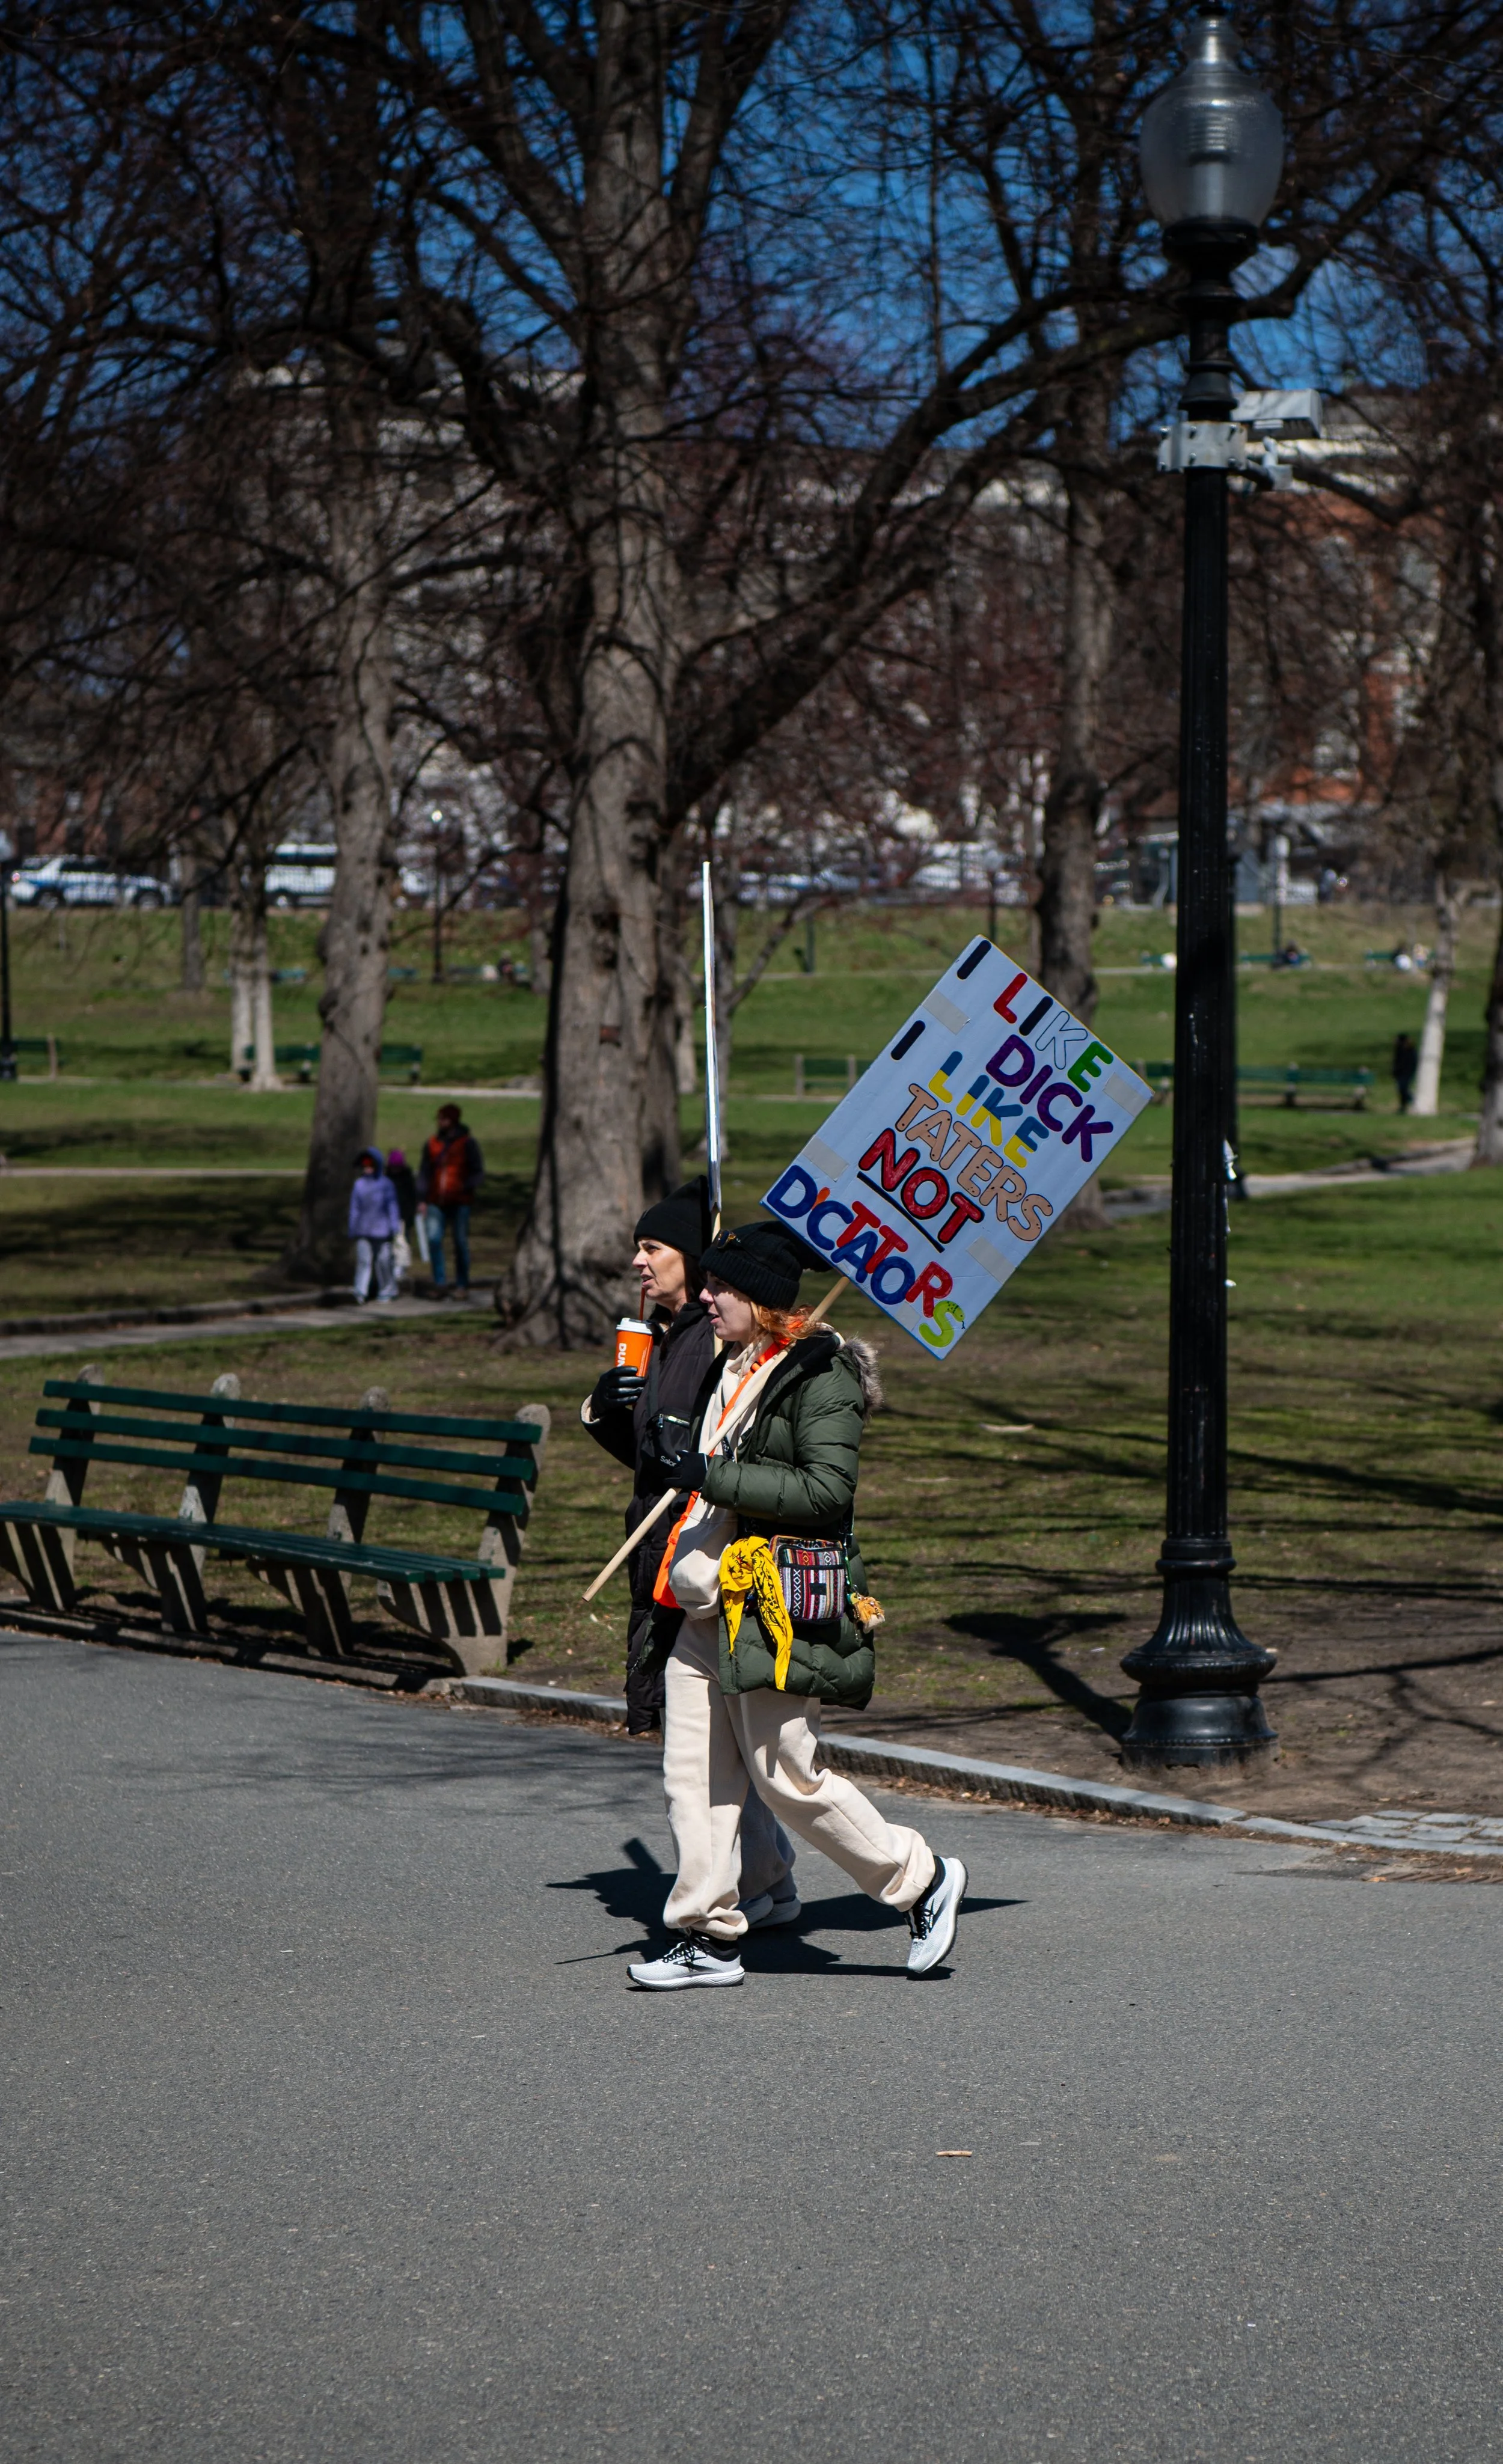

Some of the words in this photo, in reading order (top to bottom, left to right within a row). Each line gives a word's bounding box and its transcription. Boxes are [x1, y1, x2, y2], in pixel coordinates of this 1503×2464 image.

[957, 940, 992, 980] I
[993, 973, 1113, 1092] LIKE
[891, 1020, 926, 1060] I
[928, 1051, 1049, 1168] LIKE
[895, 1083, 1053, 1242] TATERS
[986, 1035, 1113, 1162] DICK
[858, 1128, 985, 1244] NOT
